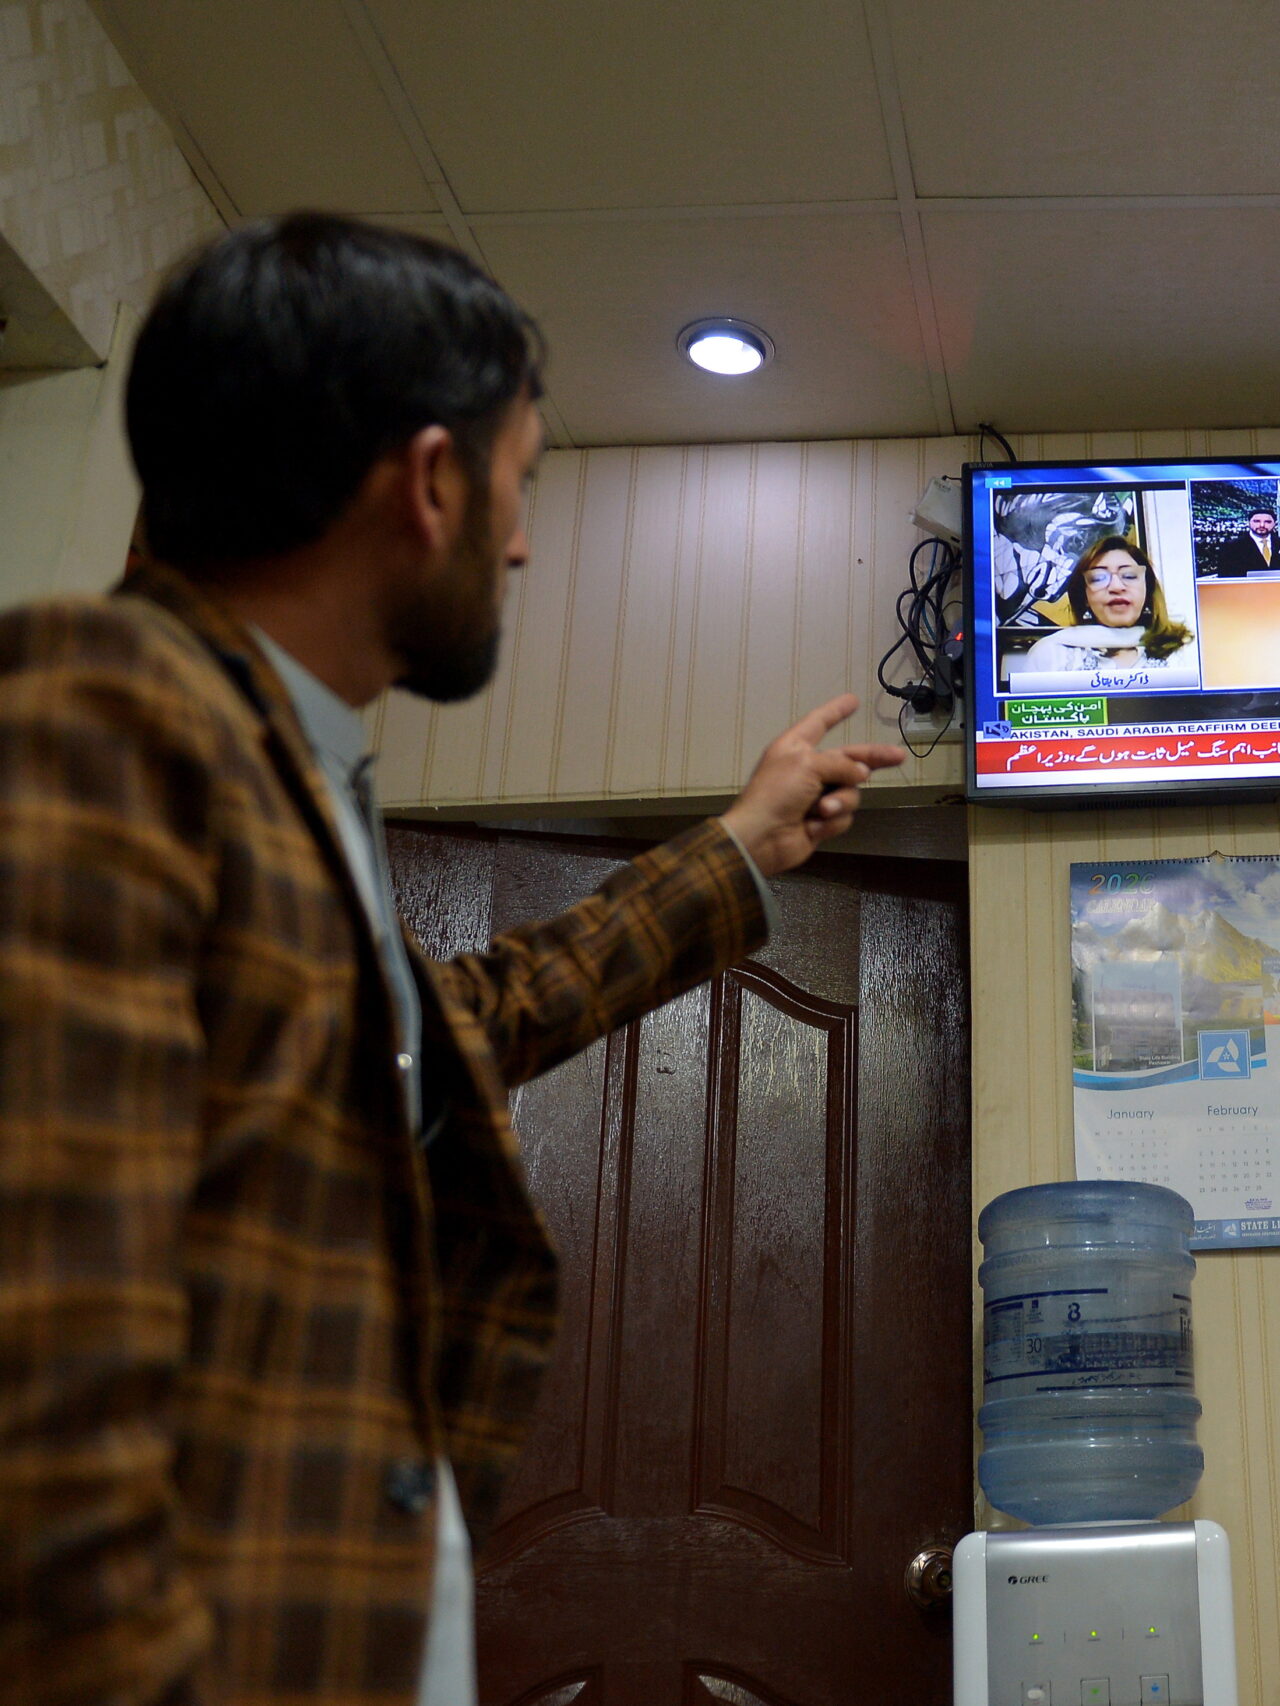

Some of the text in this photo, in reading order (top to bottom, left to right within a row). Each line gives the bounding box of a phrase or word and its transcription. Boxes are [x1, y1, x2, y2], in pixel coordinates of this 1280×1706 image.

[1022, 712, 1090, 725] پاکستان
[1002, 730, 1073, 740] AKISTAN,
[1077, 727, 1119, 737] SAUDI
[1124, 725, 1173, 735] ARABIA
[1178, 722, 1246, 733] REAFFIRM
[1107, 1109, 1154, 1120] January
[1207, 1105, 1258, 1116] February
[1240, 1220, 1269, 1231] STATE
[1026, 1338, 1043, 1354] 30
[1019, 1575, 1049, 1584] GREE
